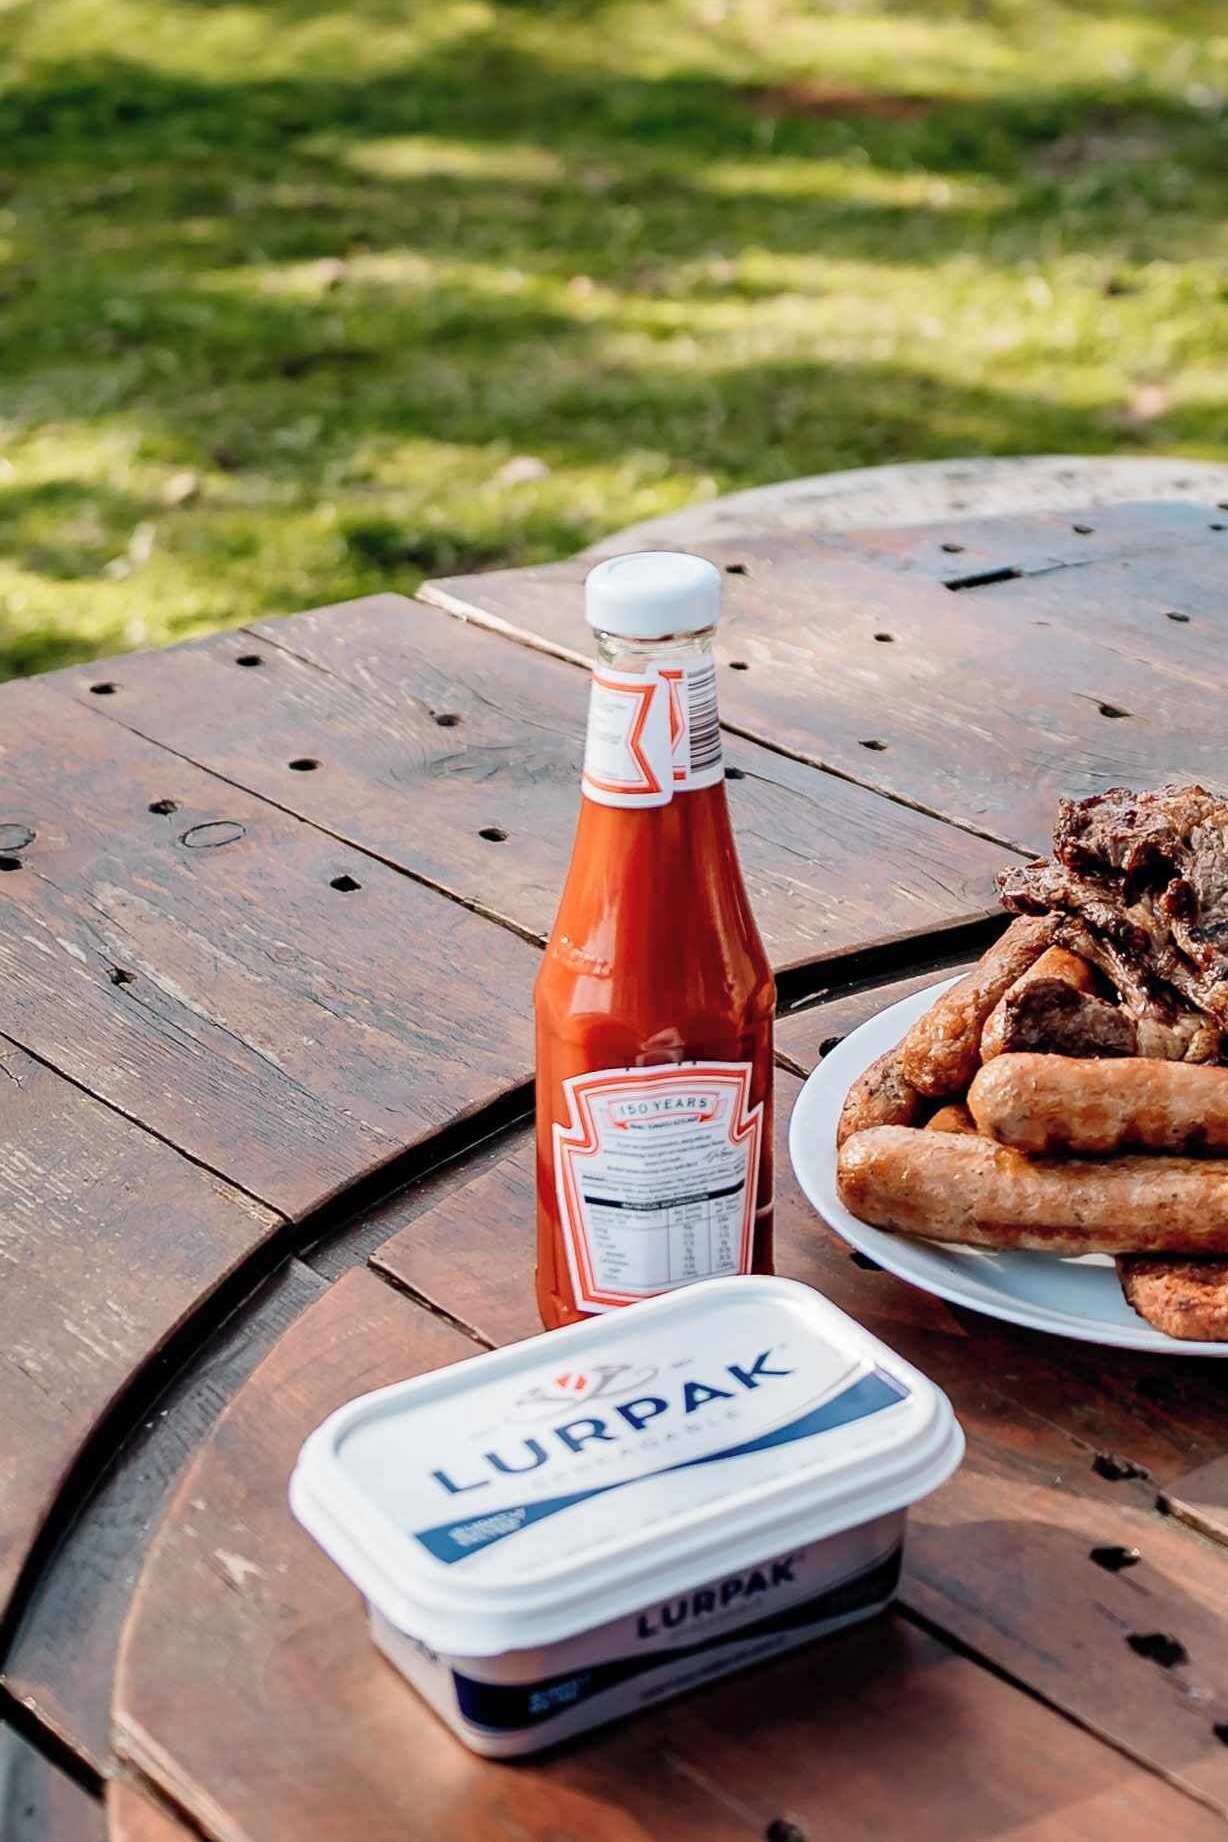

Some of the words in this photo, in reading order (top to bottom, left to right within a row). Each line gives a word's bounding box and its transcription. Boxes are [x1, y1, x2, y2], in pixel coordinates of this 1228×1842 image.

[619, 1102, 648, 1115] 150
[654, 1097, 708, 1111] YEARS
[431, 1349, 794, 1494] LURPAK
[636, 1555, 798, 1640] LURPAK
